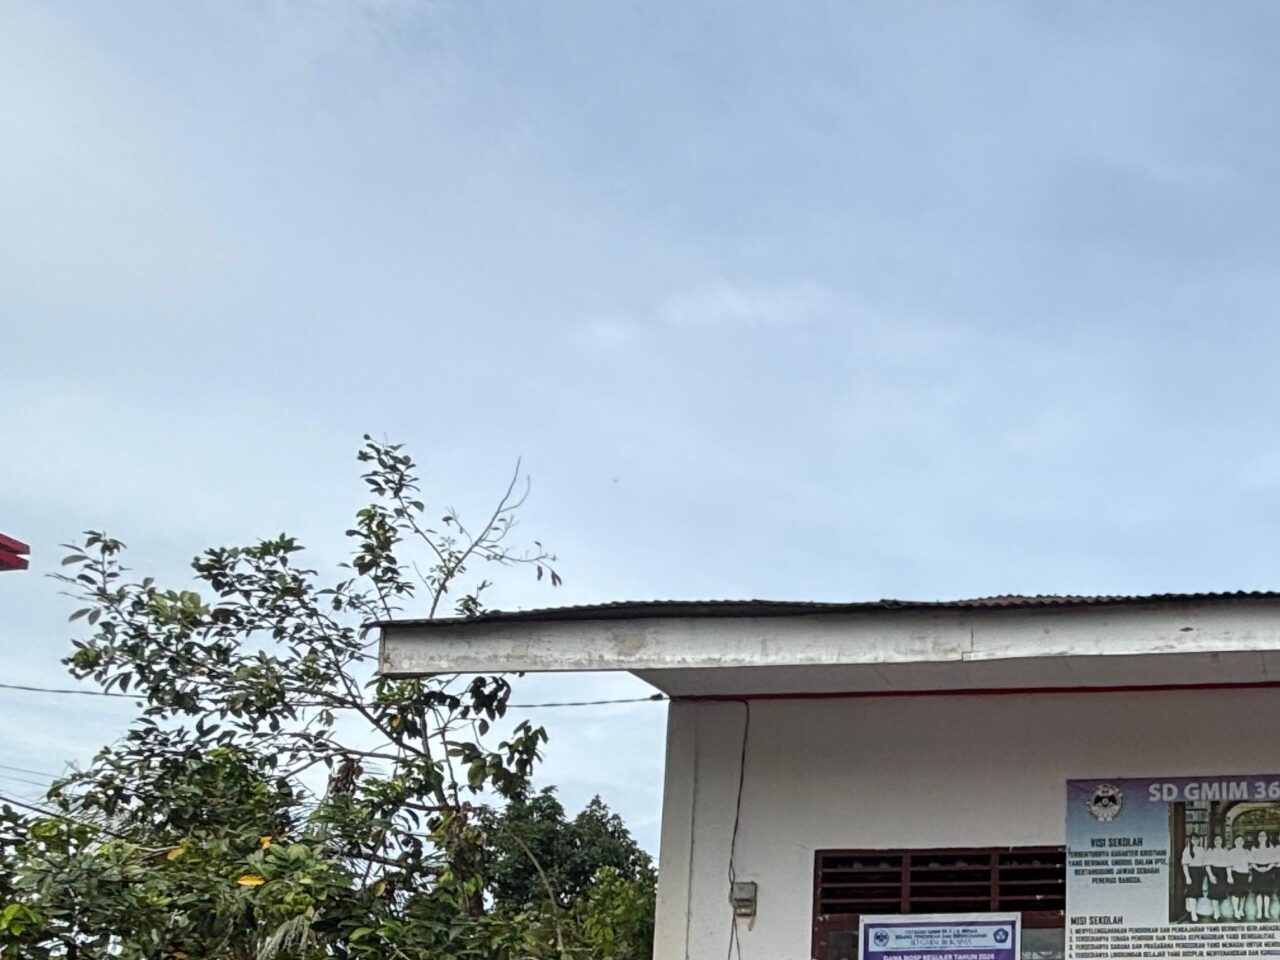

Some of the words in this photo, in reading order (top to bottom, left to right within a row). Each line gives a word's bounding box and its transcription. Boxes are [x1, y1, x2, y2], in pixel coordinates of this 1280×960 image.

[1149, 783, 1178, 801] SD
[1184, 782, 1249, 800] GMIM
[1255, 781, 1280, 799] 36
[1091, 838, 1106, 848] VISI
[1108, 837, 1143, 847] SEKOLAH
[1070, 916, 1087, 925] MISI
[1089, 916, 1123, 925] SEKOLAH
